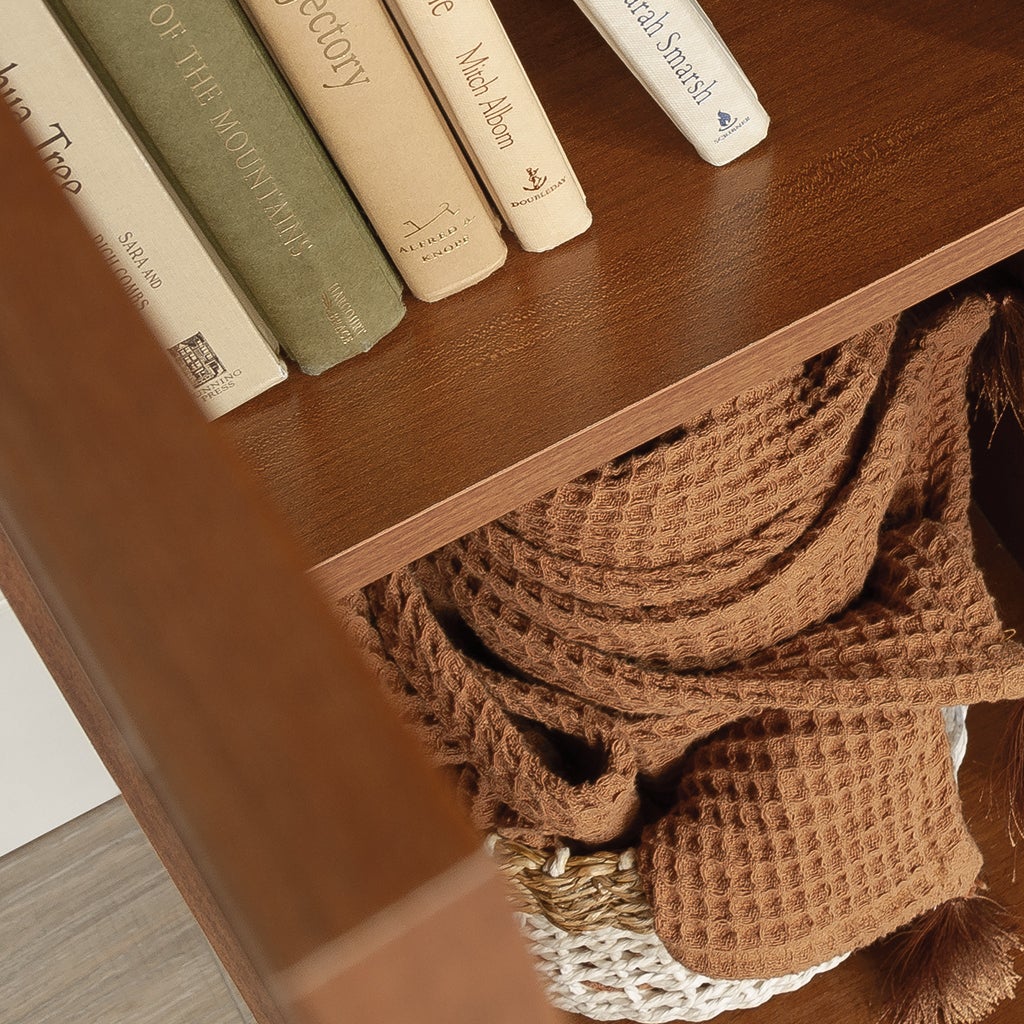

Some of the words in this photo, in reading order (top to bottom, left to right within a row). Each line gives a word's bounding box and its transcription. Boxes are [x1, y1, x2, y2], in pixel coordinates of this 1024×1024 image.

[656, 31, 718, 106] Smarsh
[455, 41, 500, 98] Mitch
[478, 95, 515, 150] Albom
[148, 3, 187, 41] OF
[174, 44, 223, 107] THE
[209, 107, 314, 258] MOUNTAINS
[510, 176, 567, 208] DOUBLEDAY
[118, 231, 150, 270] SARA
[141, 269, 163, 290] AND
[398, 226, 459, 255] ALFRED
[420, 235, 471, 264] KNOPF
[202, 380, 236, 403] PRESS
